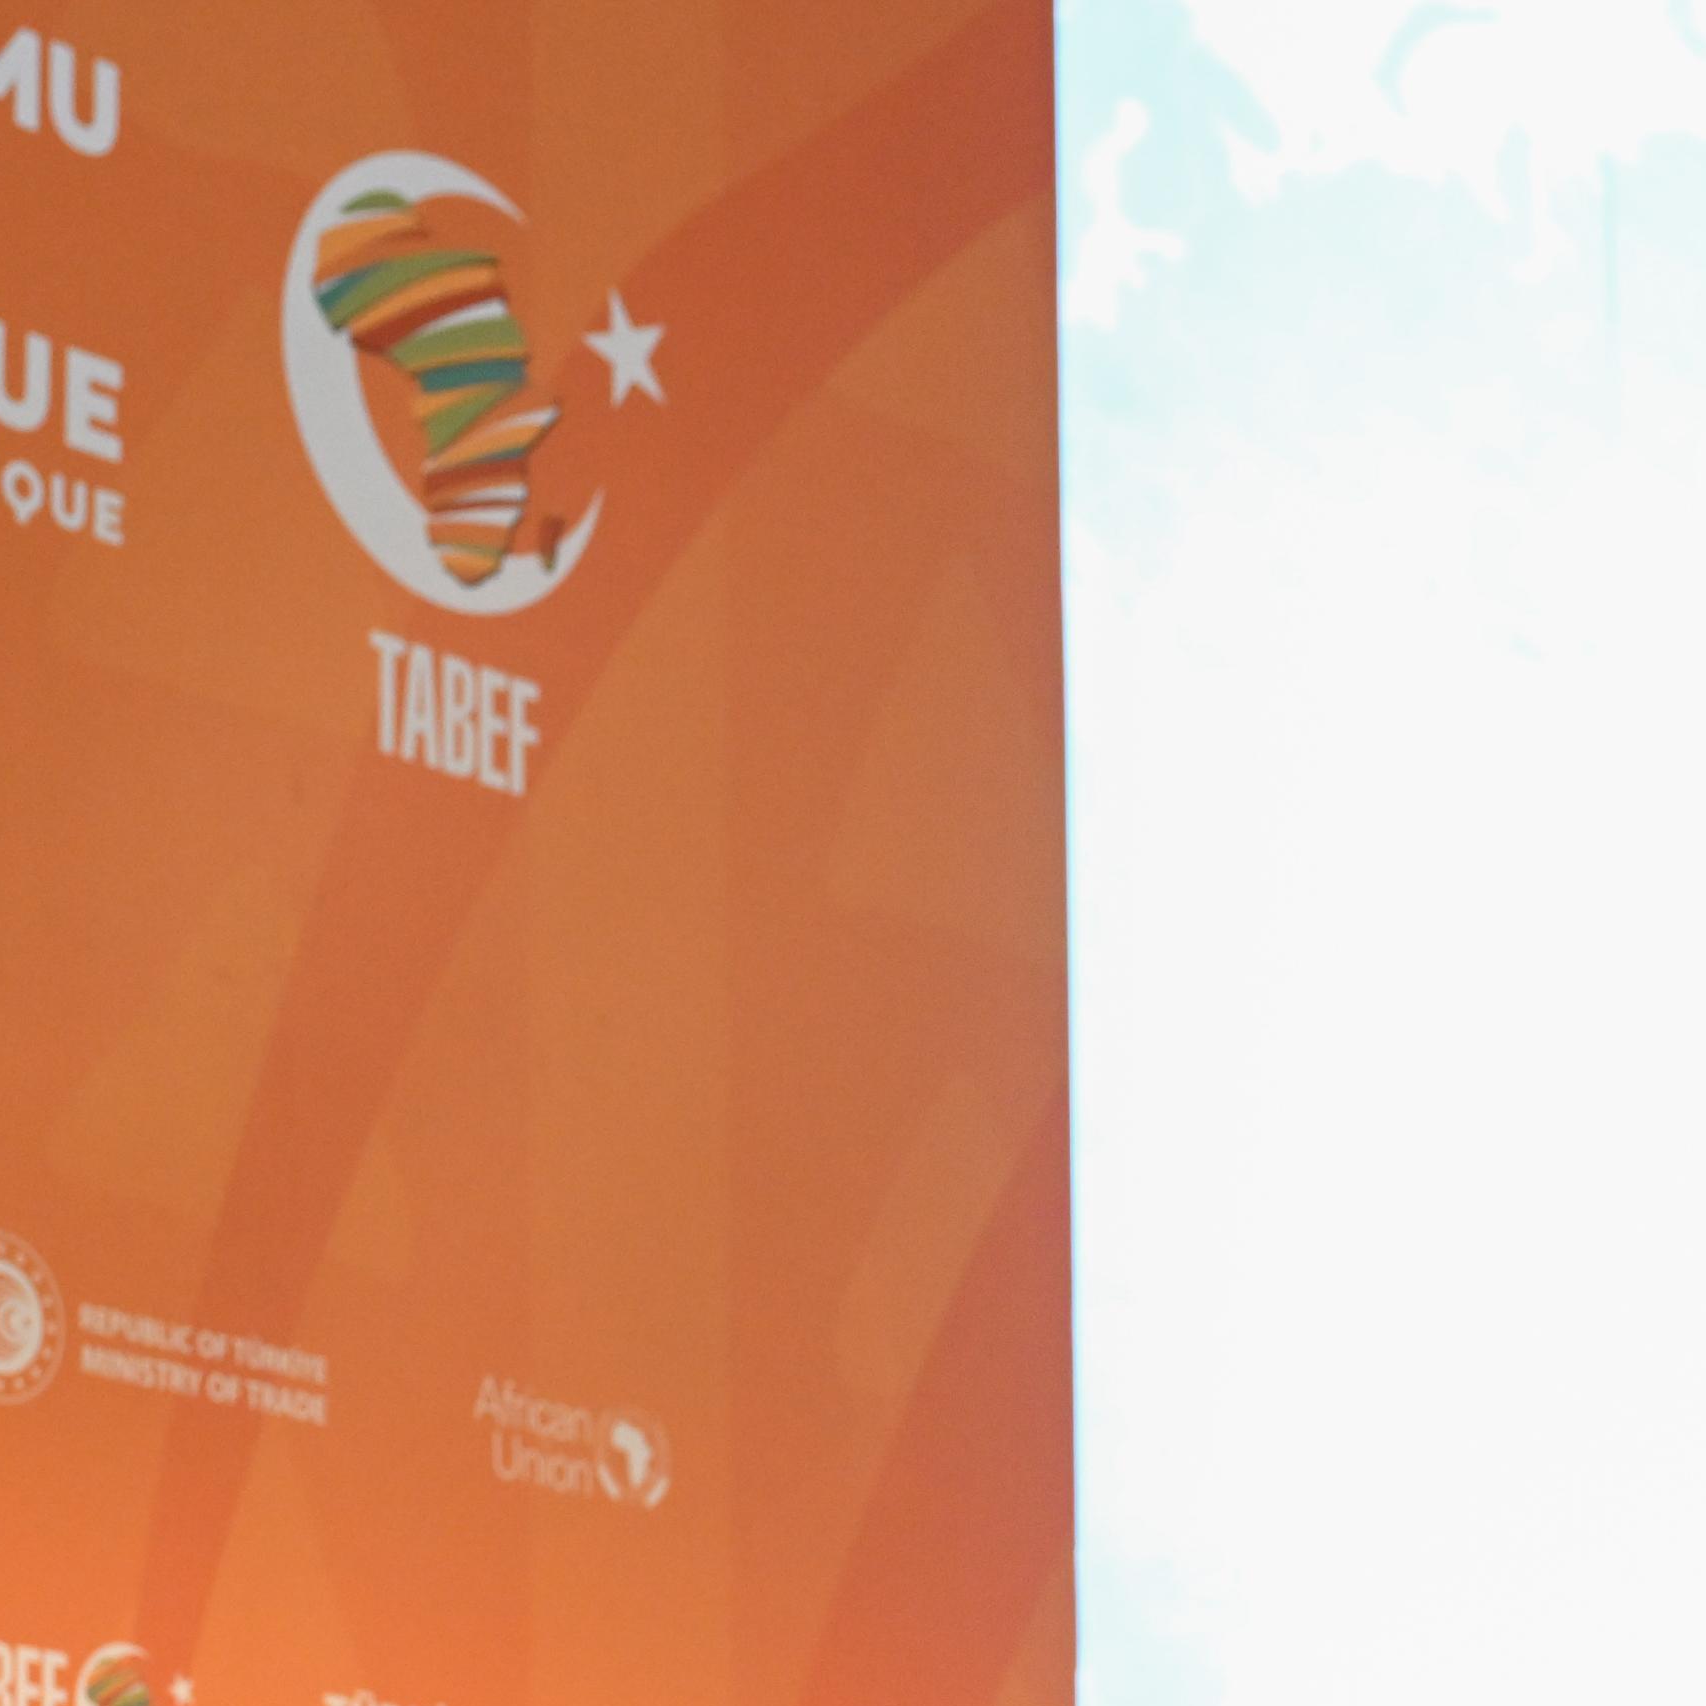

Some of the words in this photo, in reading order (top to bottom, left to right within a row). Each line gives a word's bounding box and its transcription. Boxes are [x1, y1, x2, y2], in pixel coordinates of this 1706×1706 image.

[369, 629, 541, 796] TABEF
[473, 1374, 594, 1441] African
[491, 1427, 594, 1499] Union
